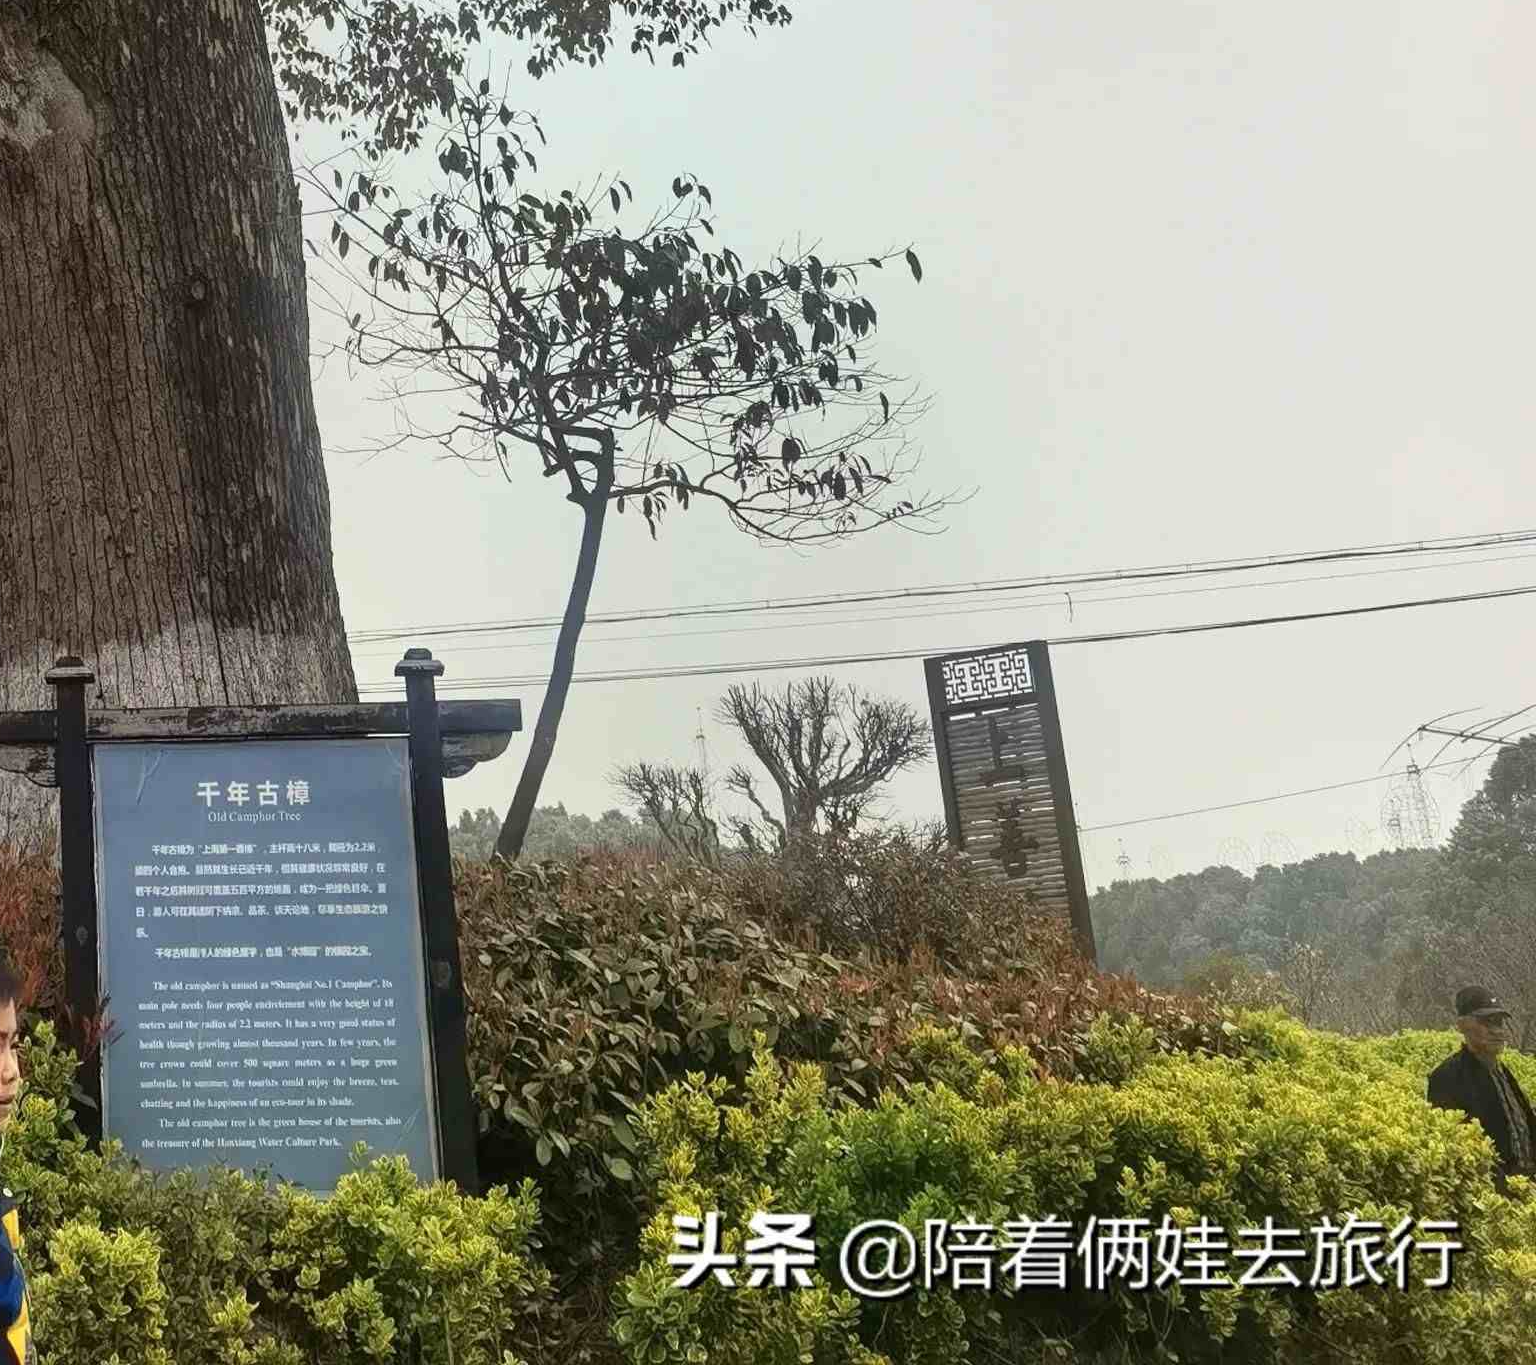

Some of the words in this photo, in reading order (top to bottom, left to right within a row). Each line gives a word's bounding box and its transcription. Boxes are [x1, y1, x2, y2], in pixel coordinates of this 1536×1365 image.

[196, 781, 311, 806] 千年古樟
[208, 811, 227, 822] Old
[229, 810, 275, 823] Camphor
[279, 810, 301, 821] Tree
